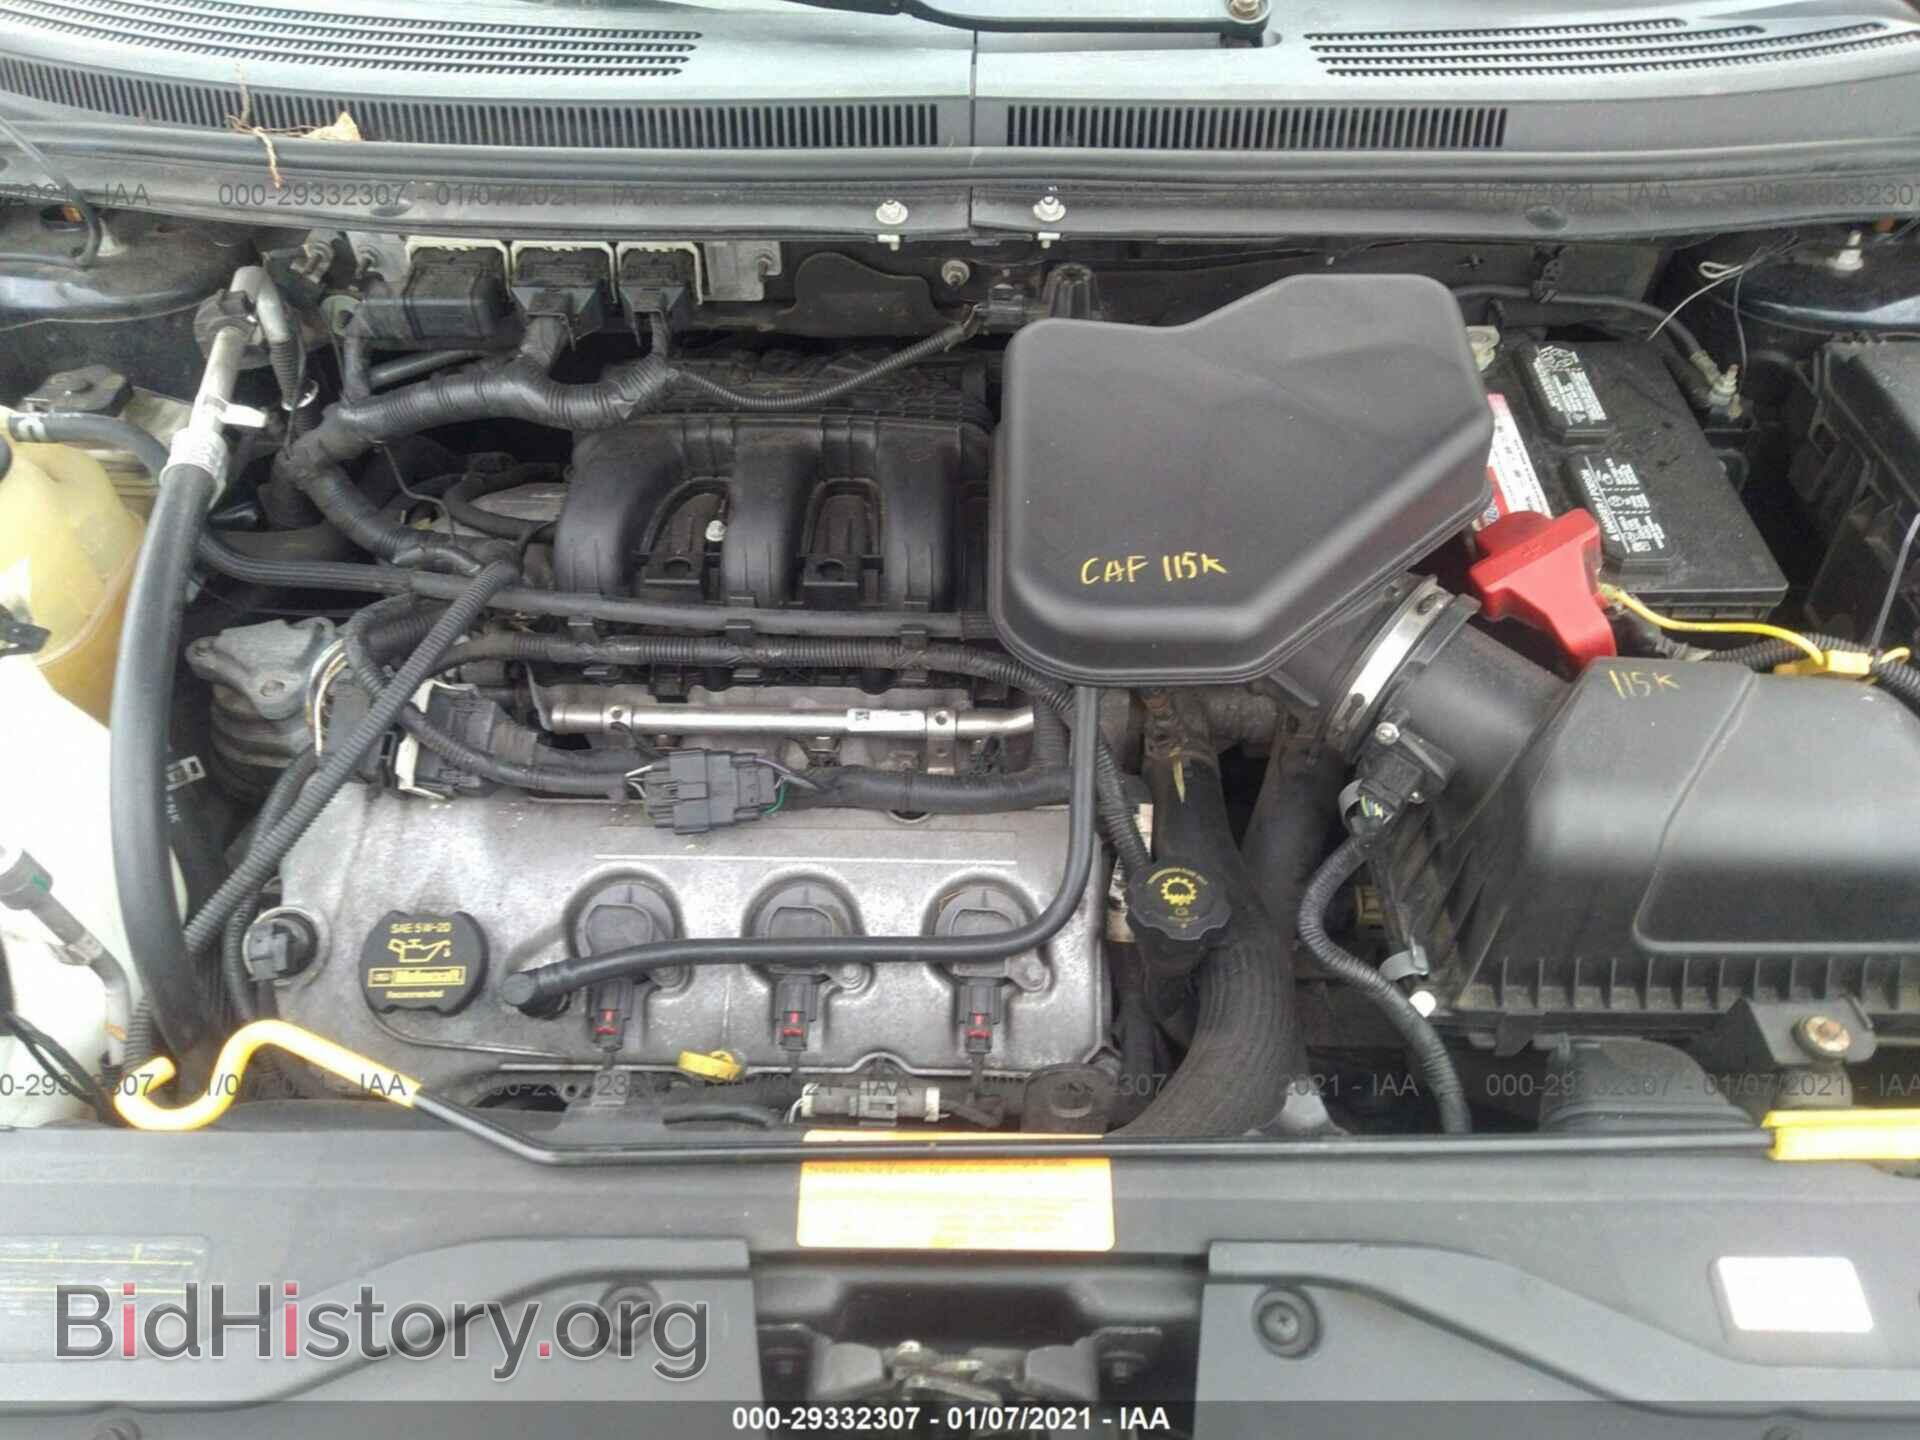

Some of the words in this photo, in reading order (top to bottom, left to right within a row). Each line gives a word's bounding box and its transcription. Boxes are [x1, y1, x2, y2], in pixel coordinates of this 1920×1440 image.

[1081, 556, 1149, 585] CAF
[1162, 551, 1228, 582] 115K
[1608, 669, 1681, 700] 115K
